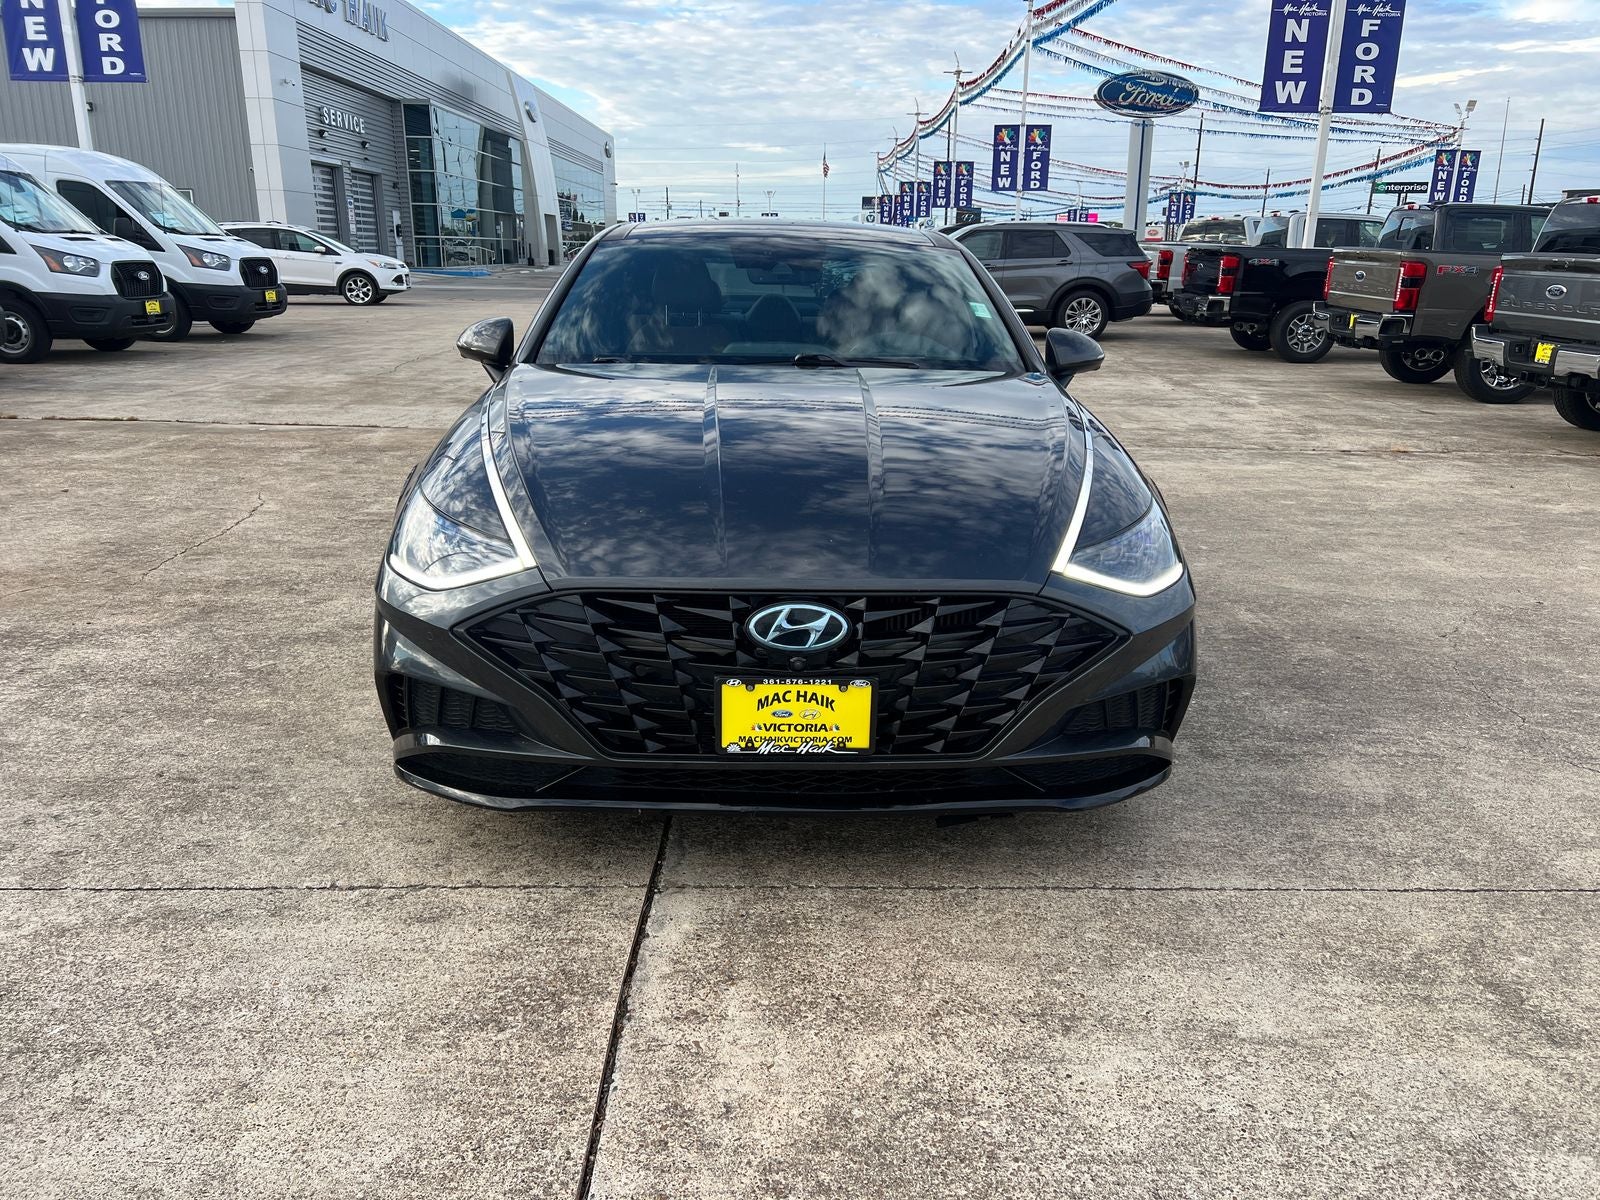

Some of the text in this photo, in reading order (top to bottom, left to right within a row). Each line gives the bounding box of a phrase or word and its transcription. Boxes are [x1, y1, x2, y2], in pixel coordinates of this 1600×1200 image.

[94, 0, 125, 75] ORD
[1274, 18, 1309, 104] NEW
[1350, 19, 1381, 106] FORD
[1118, 79, 1179, 107] Ford
[322, 106, 366, 134] SERVICE
[997, 151, 1012, 188] NEW
[1029, 152, 1042, 189] FORD
[936, 180, 947, 206] NEW
[959, 180, 967, 206] FORD
[1377, 184, 1428, 192] enterprise
[1433, 171, 1448, 200] NEW
[1459, 172, 1471, 202] FORD
[903, 196, 911, 216] NEW
[1169, 205, 1177, 223] NEW
[1436, 264, 1480, 277] FX4
[756, 690, 836, 712] MAC HAIK
[763, 723, 829, 733] VICTORIA
[756, 741, 836, 754] Mac Haik
